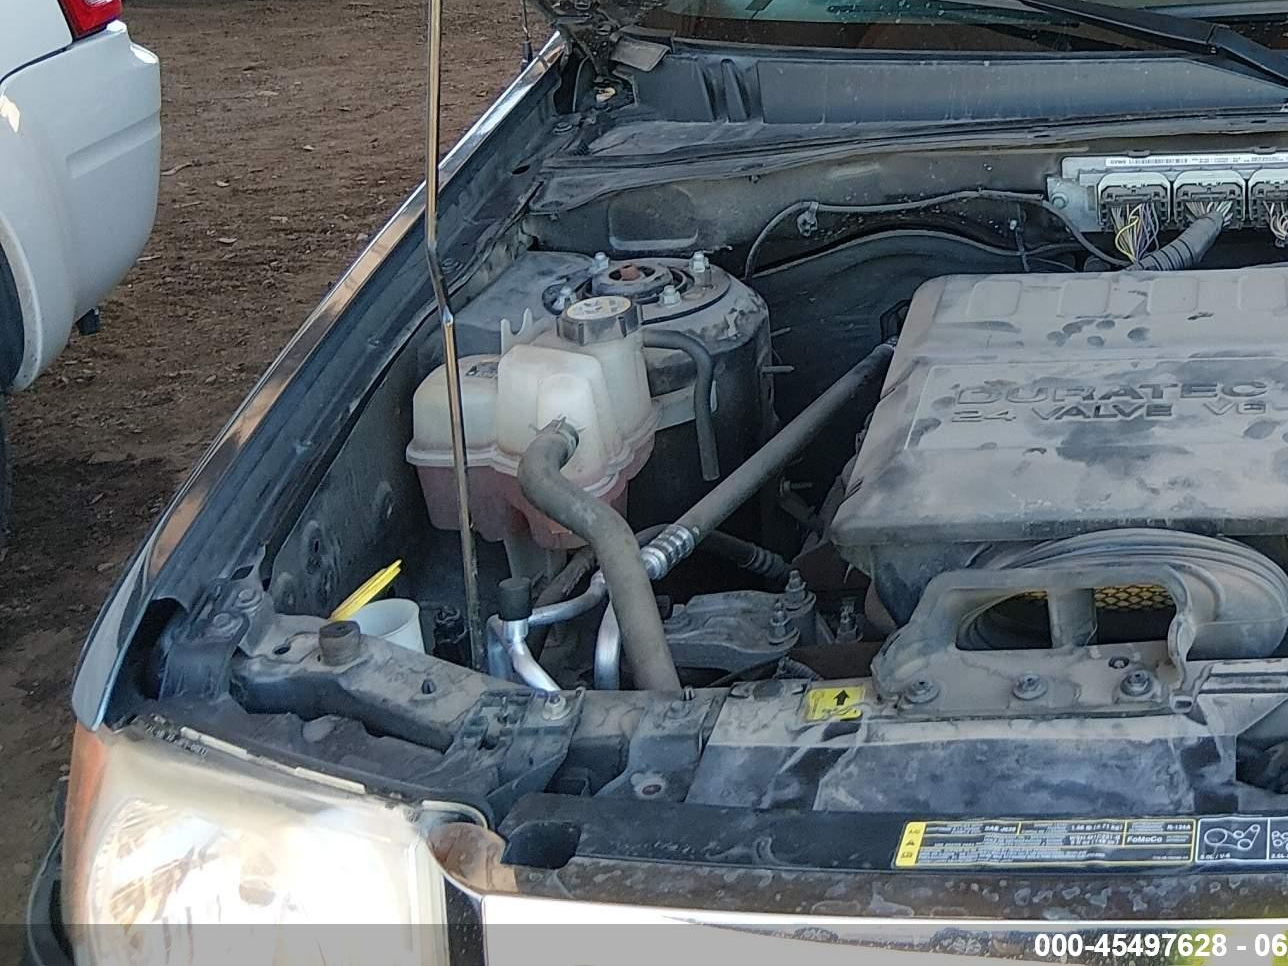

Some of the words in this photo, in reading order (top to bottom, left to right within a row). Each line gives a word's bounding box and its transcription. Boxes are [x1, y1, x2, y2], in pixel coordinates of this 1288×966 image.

[956, 380, 1268, 405] DURATEC
[951, 408, 1017, 423] 24
[1031, 403, 1173, 421] VALVE
[1202, 400, 1267, 416] V6
[1126, 835, 1163, 843] FoMoCo
